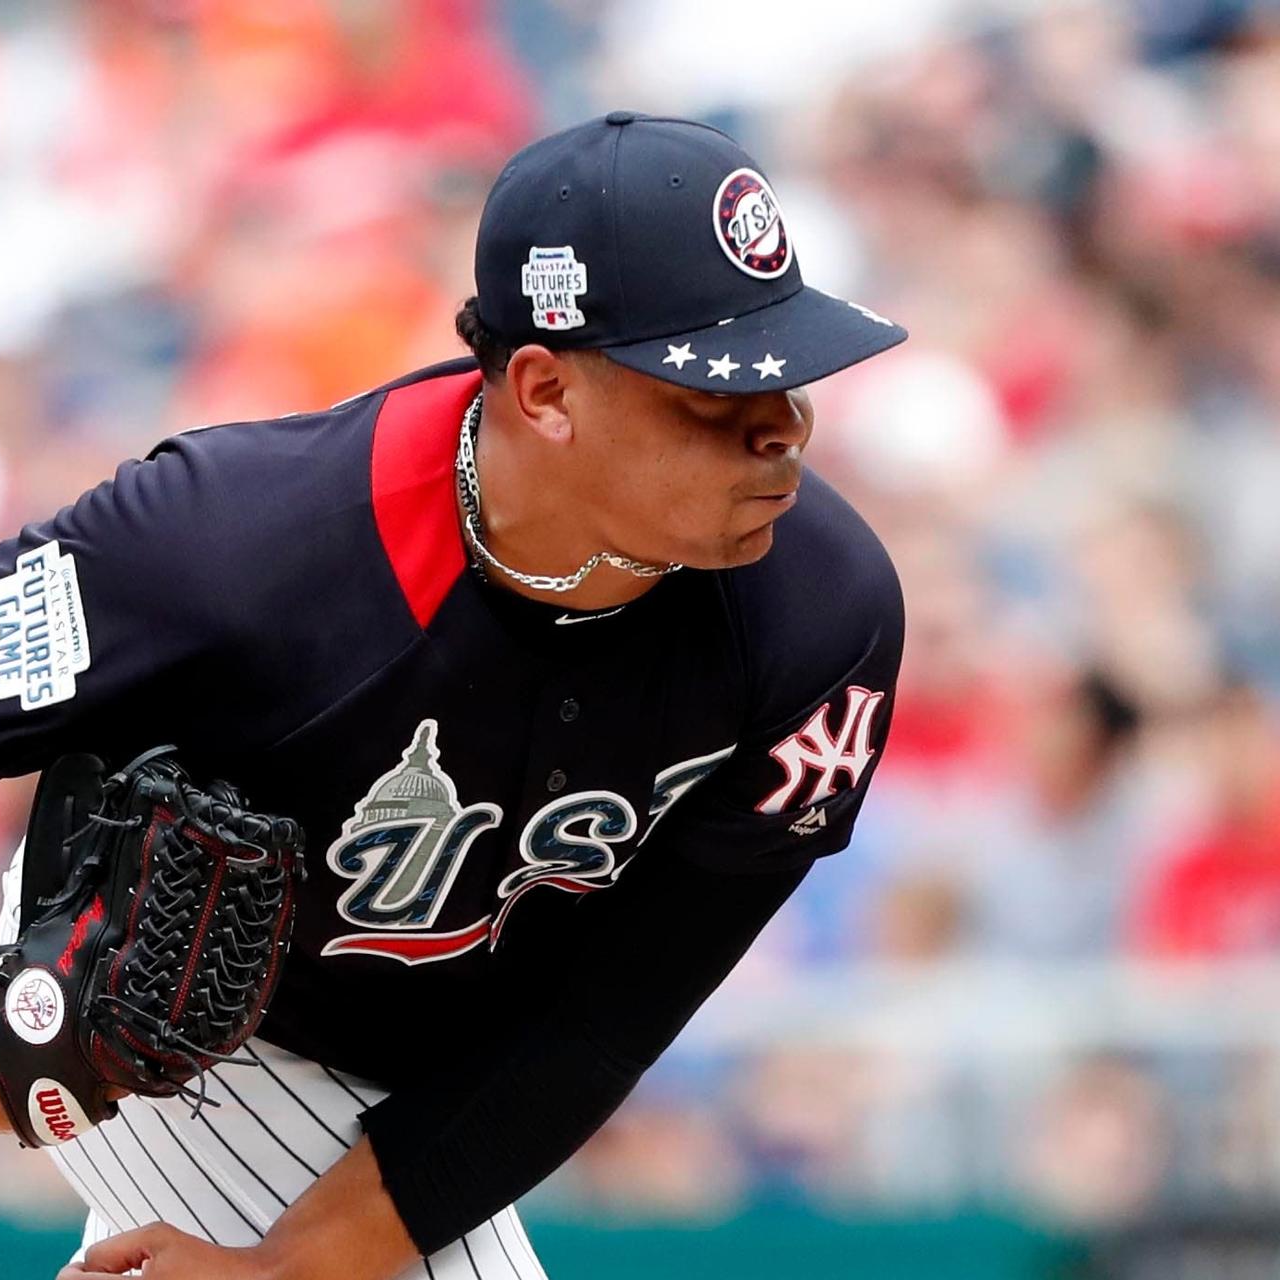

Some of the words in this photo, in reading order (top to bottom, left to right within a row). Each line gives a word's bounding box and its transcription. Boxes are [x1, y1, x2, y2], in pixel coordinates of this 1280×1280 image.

[731, 192, 778, 245] USA
[525, 273, 582, 291] FUTURES
[536, 293, 571, 310] GAME
[22, 554, 54, 704] FUTURES
